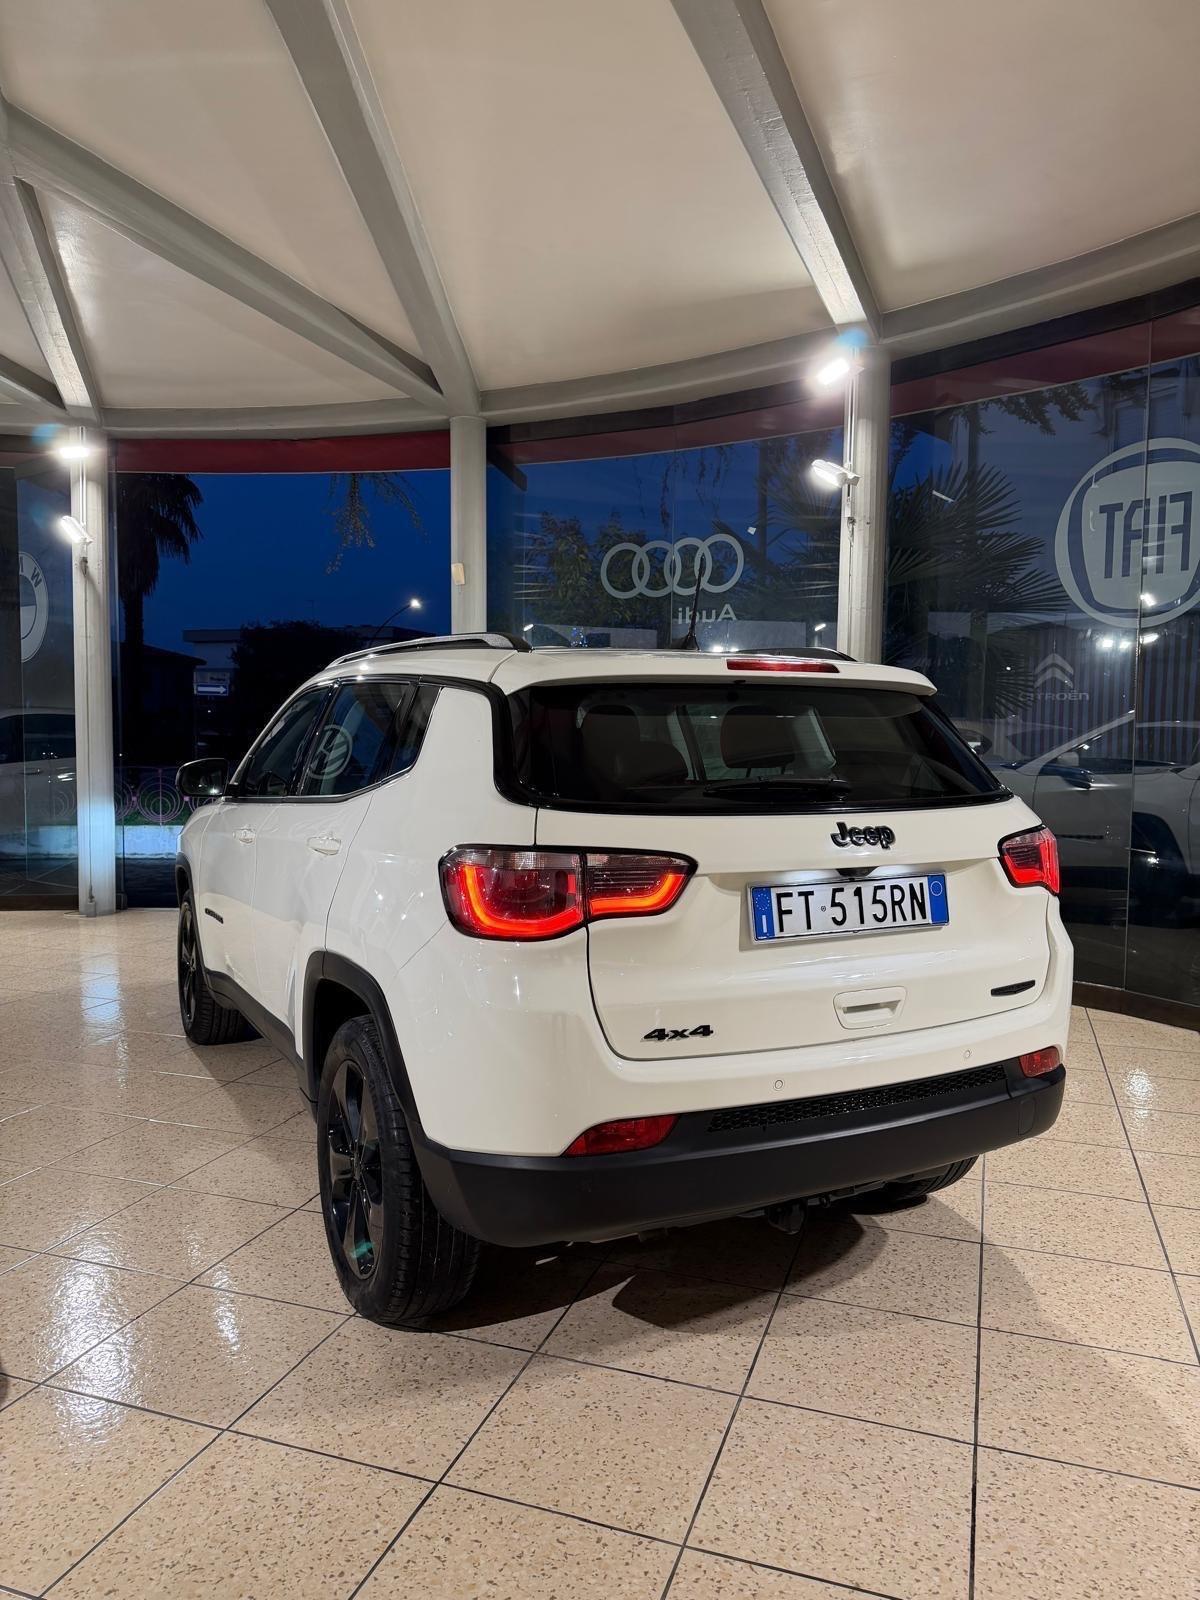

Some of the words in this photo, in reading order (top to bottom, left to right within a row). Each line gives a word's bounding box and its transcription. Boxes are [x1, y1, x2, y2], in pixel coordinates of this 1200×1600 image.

[830, 821, 896, 850] Jeep
[776, 890, 815, 933] FT
[830, 882, 927, 926] 515RN
[643, 1024, 714, 1041] 4x4
